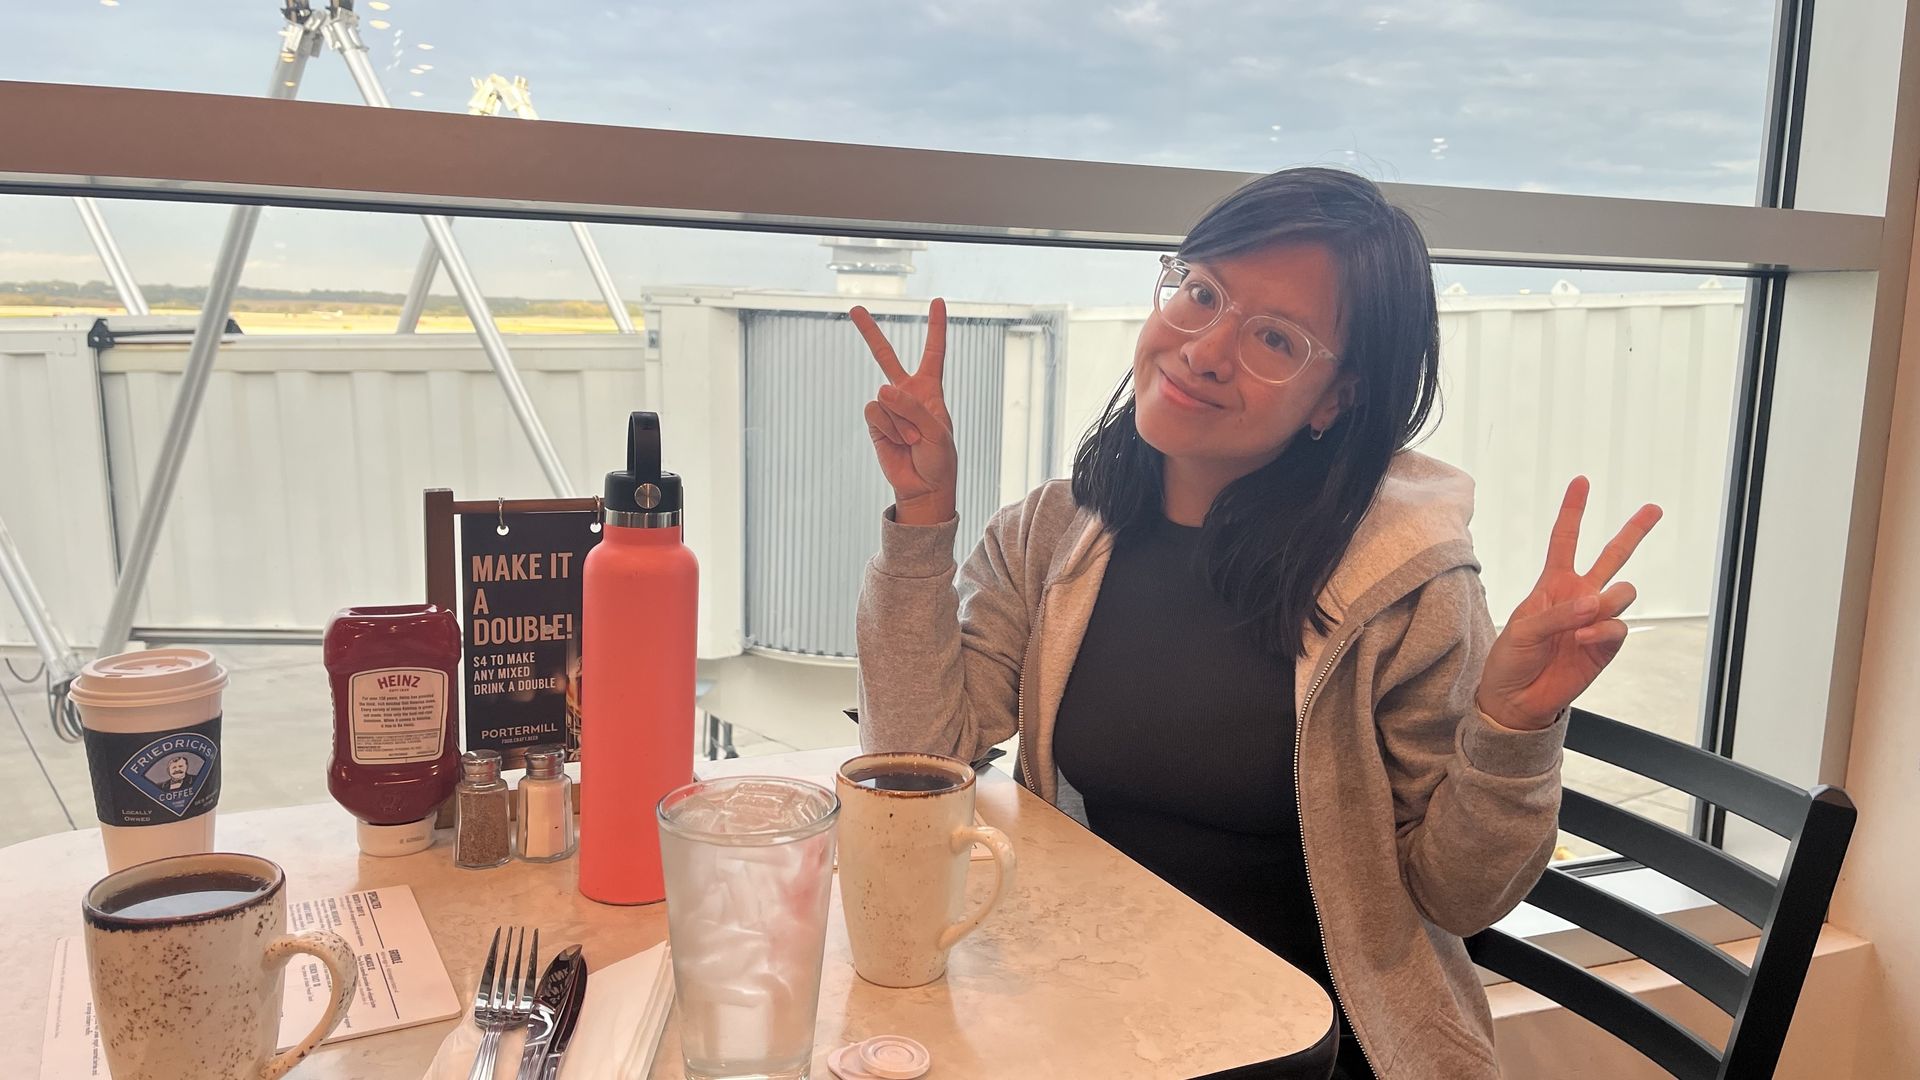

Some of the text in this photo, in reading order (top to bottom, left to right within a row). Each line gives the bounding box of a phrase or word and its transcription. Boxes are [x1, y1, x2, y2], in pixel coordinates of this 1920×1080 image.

[472, 553, 573, 582] MAKE IT
[472, 588, 490, 615] A
[474, 614, 573, 645] DOUBLE!
[490, 653, 504, 666] TO
[506, 651, 536, 665] MAKE
[377, 675, 420, 689] HEINZ
[473, 666, 530, 682] ANY MIXED
[473, 677, 556, 696] DRINK A DOUBLE
[481, 723, 558, 739] PORTERMILL
[130, 739, 212, 774] FRIEDRICHS
[159, 788, 194, 801] COFFEE
